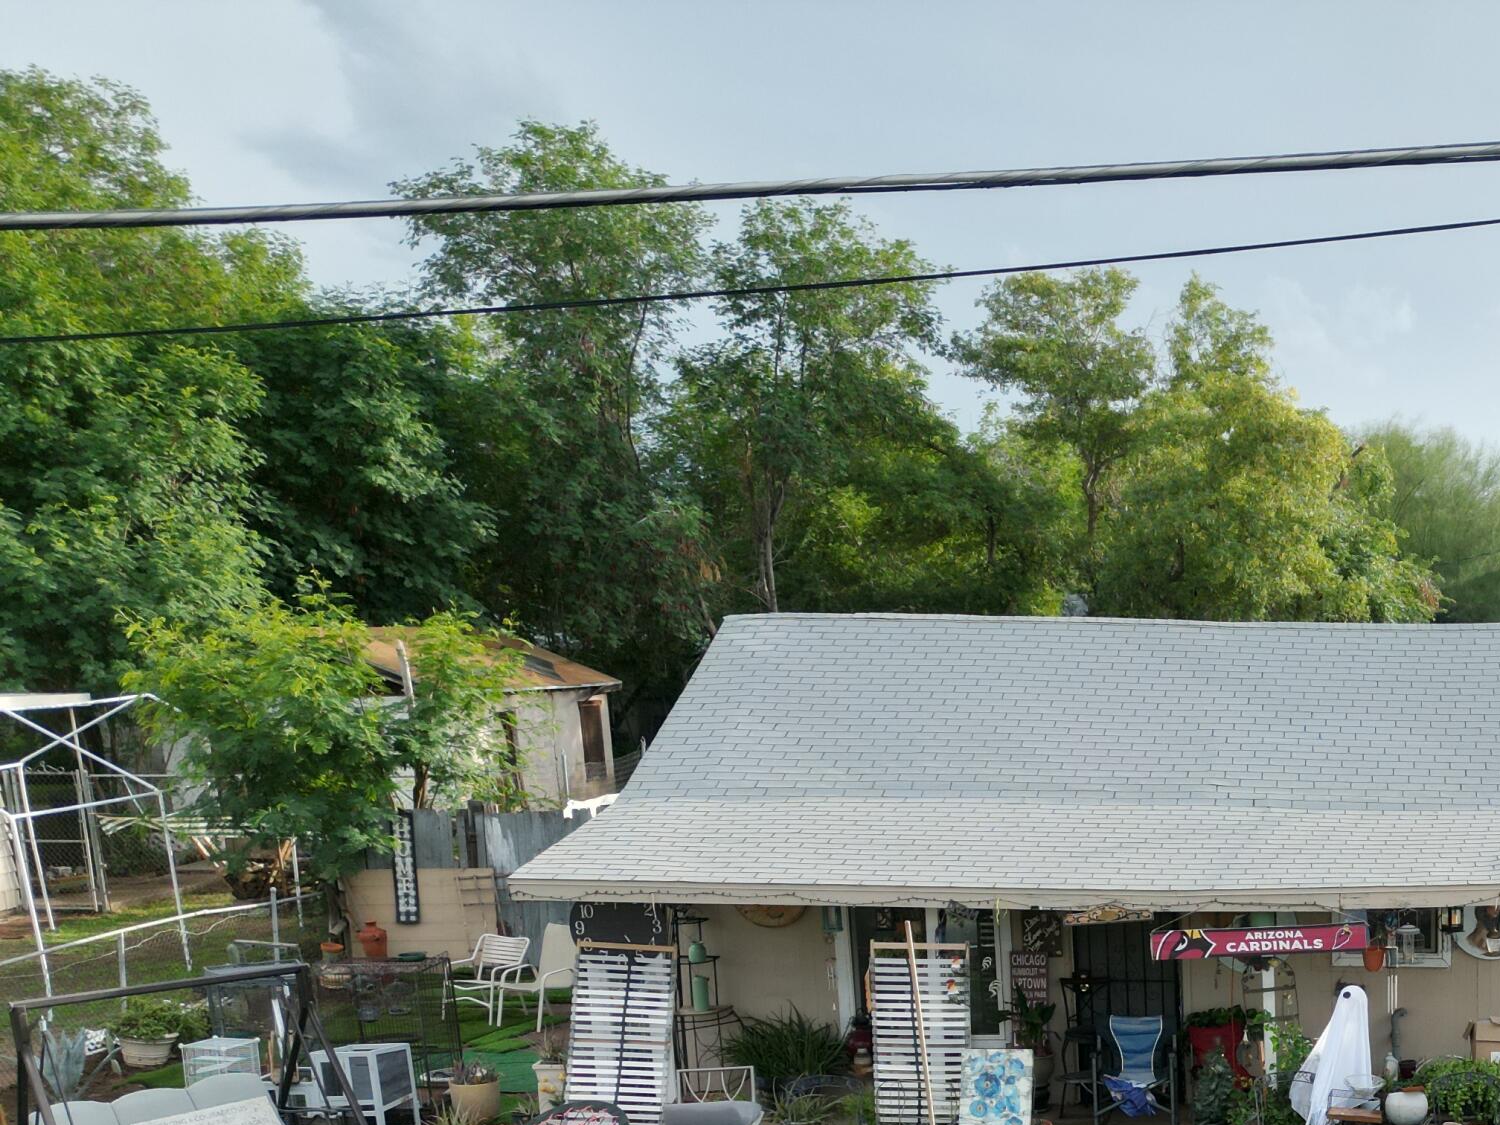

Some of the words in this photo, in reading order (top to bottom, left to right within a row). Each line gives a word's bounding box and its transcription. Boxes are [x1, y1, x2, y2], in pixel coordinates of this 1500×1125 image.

[580, 904, 594, 919] 10
[643, 903, 655, 917] 2
[575, 920, 585, 935] 9
[652, 919, 662, 934] 3
[1245, 930, 1303, 940] ARIZONA
[1226, 939, 1323, 952] CARDINALS
[1011, 954, 1047, 966] CHICAGO
